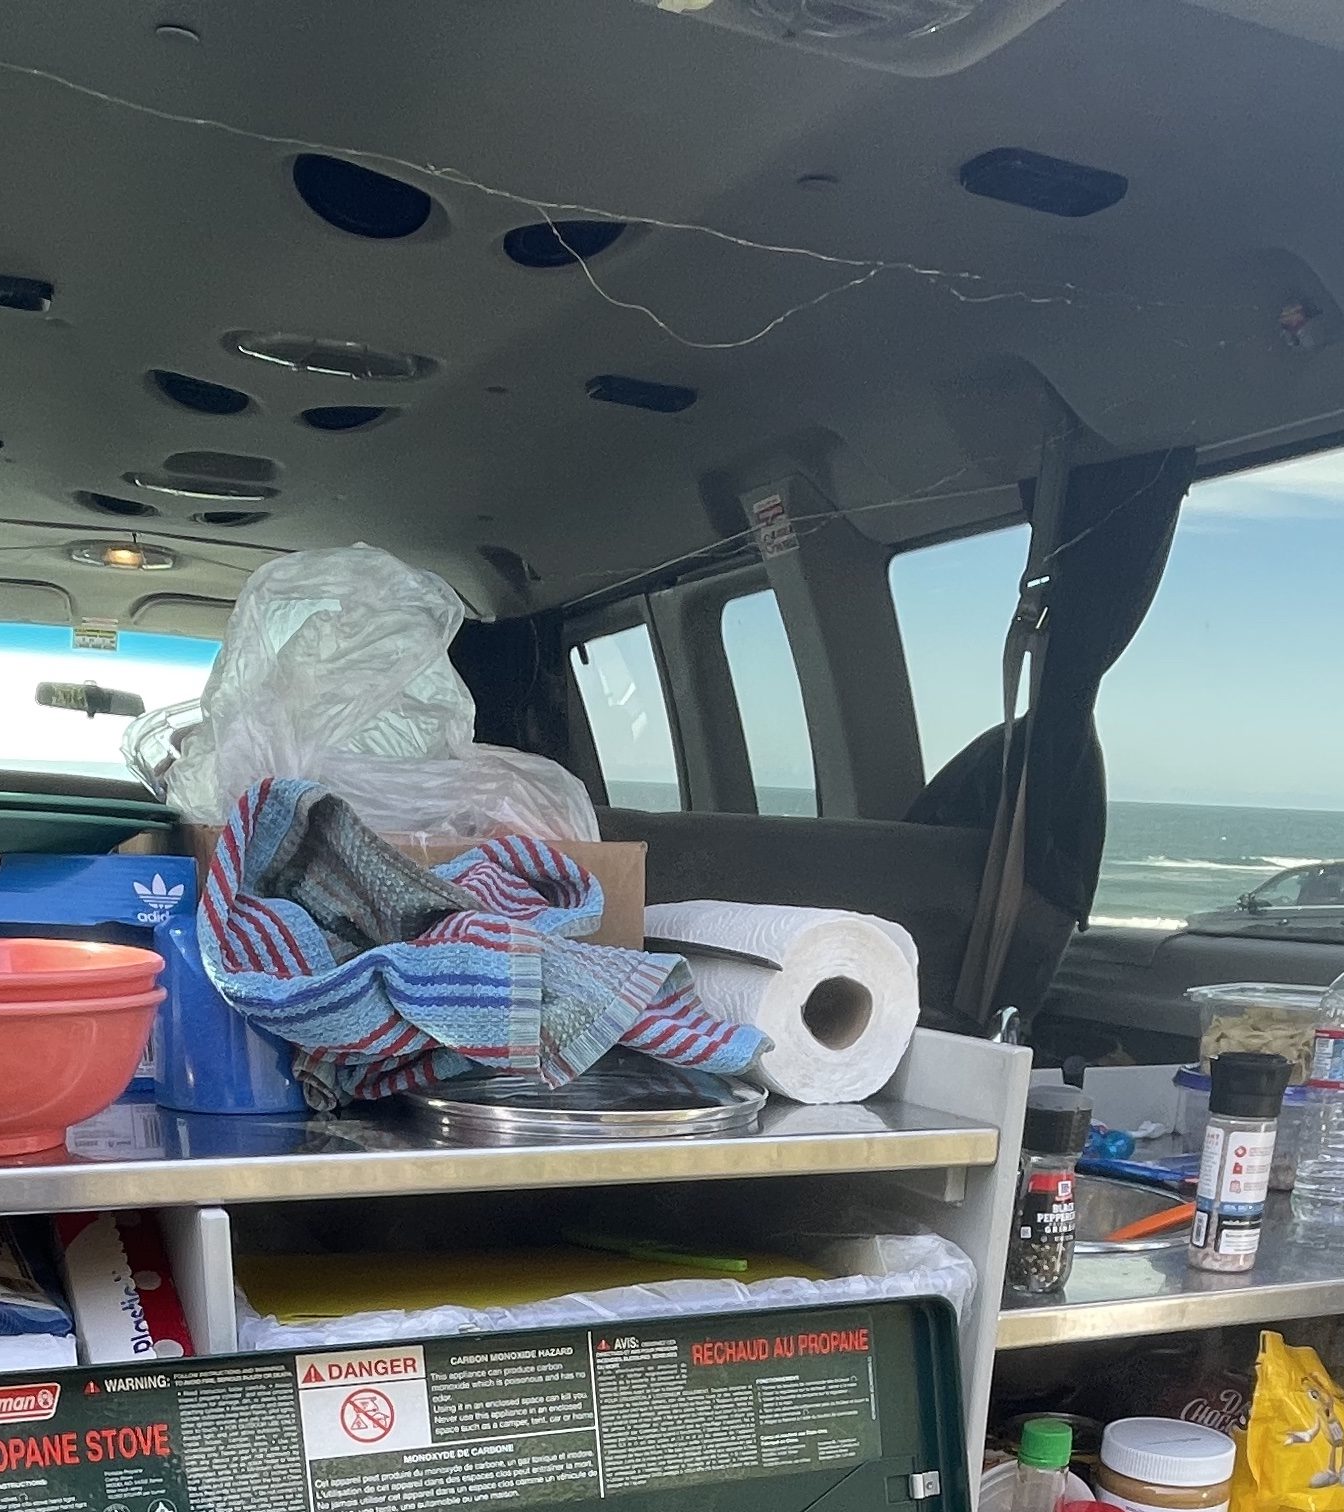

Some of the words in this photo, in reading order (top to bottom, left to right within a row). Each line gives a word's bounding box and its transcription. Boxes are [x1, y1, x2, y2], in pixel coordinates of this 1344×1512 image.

[137, 911, 170, 922] adid
[614, 1337, 640, 1350] AVIS:
[773, 1335, 795, 1358] AU
[797, 1328, 869, 1356] PROPANE
[450, 1353, 488, 1365] CARBON
[490, 1350, 537, 1362] MONOXIDE
[538, 1347, 573, 1358] HAZARD
[328, 1357, 417, 1380] DANGER
[488, 1369, 503, 1377] can
[504, 1365, 536, 1377] produce
[536, 1363, 563, 1372] carbon
[105, 1375, 171, 1393] WARNING:
[471, 1379, 495, 1388] which
[545, 1373, 559, 1381] and
[560, 1372, 574, 1380] has
[85, 1423, 170, 1462] STOVE
[403, 1450, 456, 1463] MONOXYDE
[457, 1449, 470, 1458] DE
[471, 1443, 515, 1456] CARBONE
